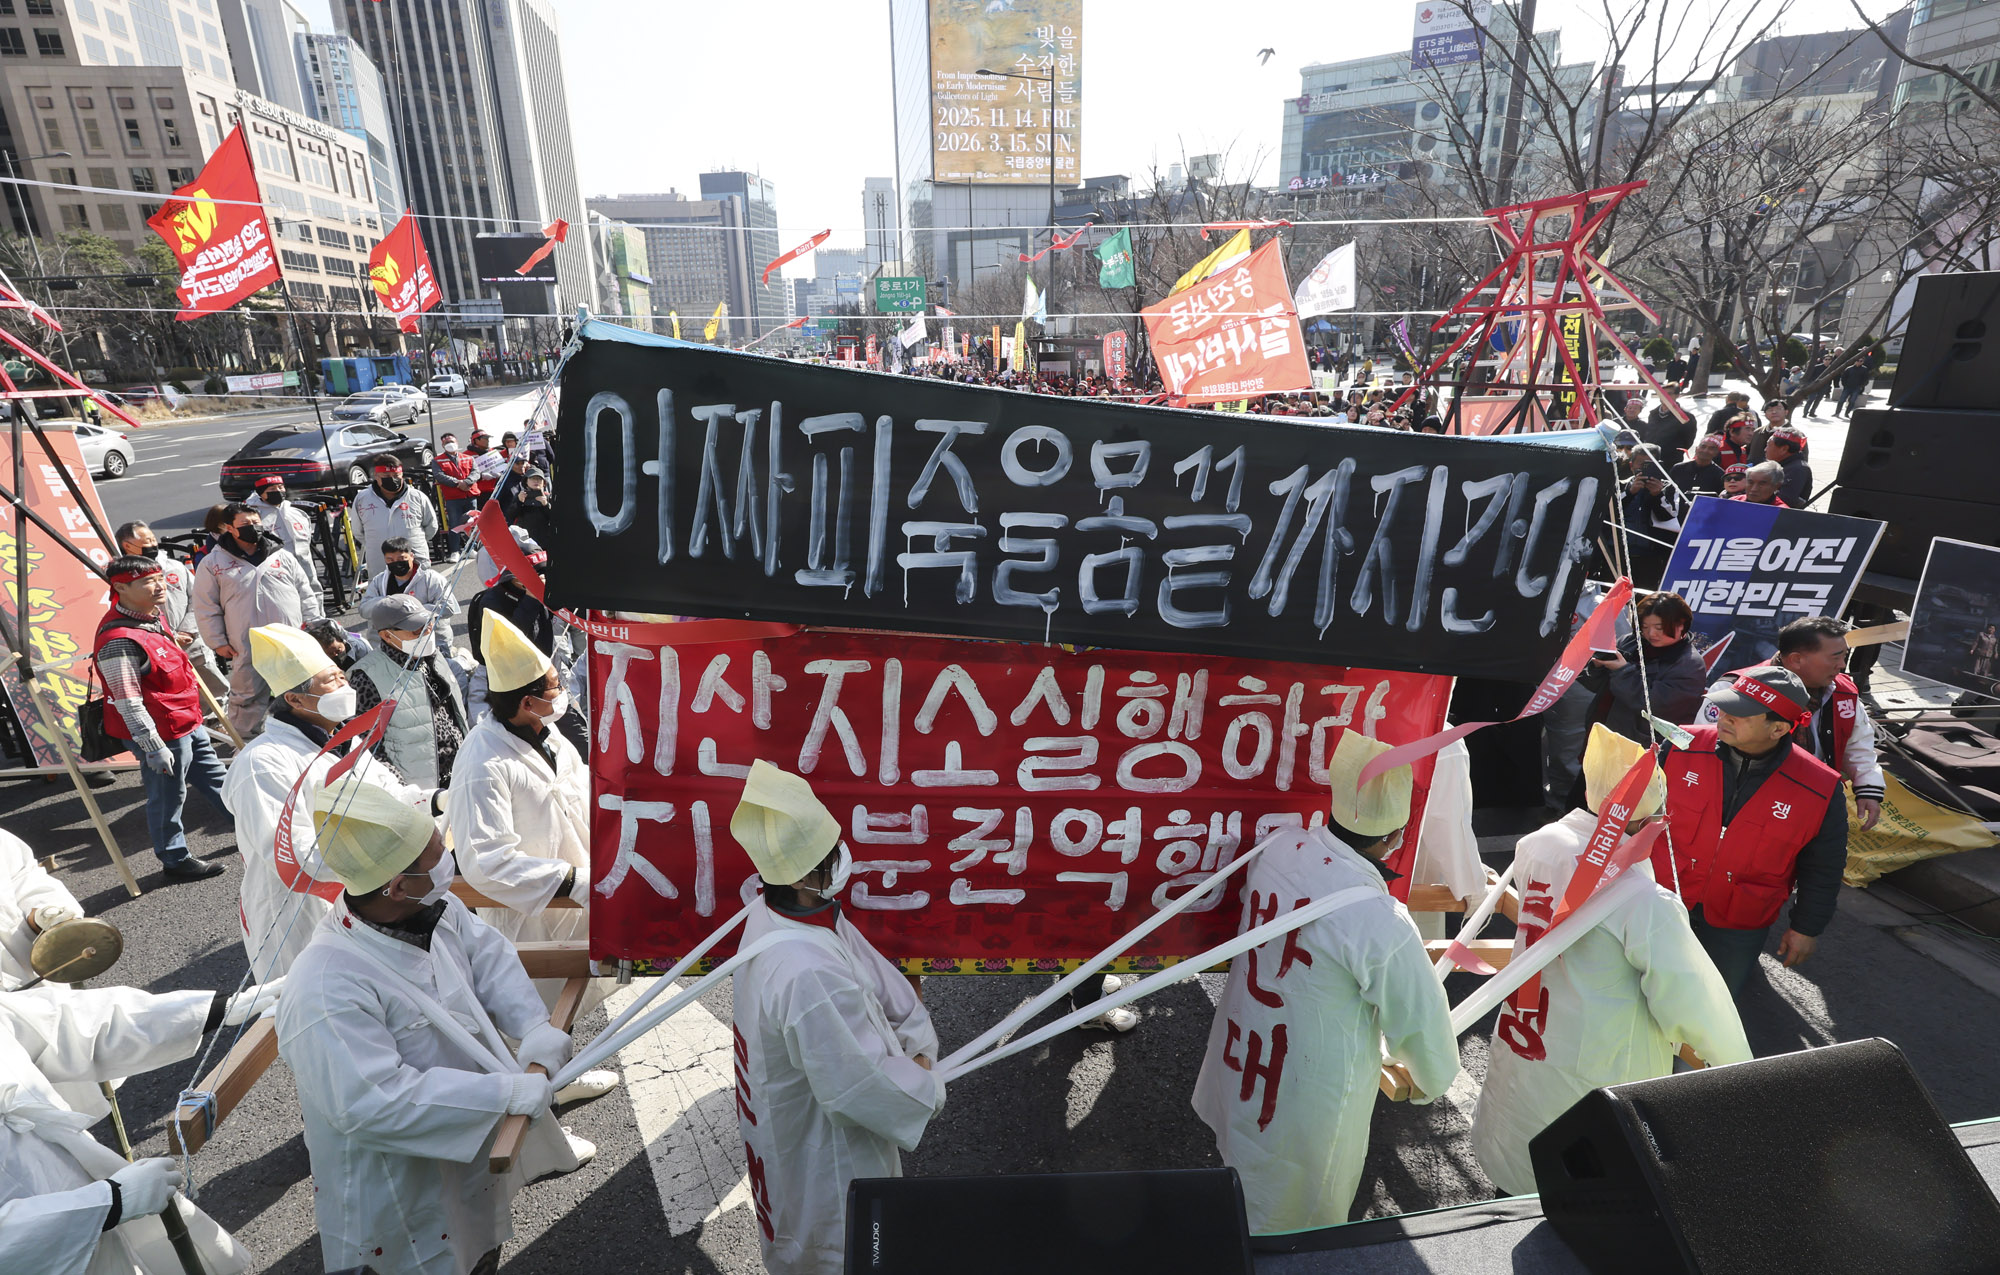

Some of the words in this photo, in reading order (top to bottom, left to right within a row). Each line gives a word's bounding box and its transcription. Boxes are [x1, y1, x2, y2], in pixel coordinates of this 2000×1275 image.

[1037, 24, 1077, 49] 빛을
[1419, 39, 1436, 49] ETS
[1418, 47, 1447, 58] TOEFL
[937, 71, 956, 79] From
[1015, 52, 1077, 77] 수집한
[937, 82, 945, 90] to
[946, 81, 965, 91] Early
[972, 92, 979, 100] of
[1015, 79, 1077, 104] 사람들
[937, 107, 985, 127] 2025.
[989, 108, 1010, 127] 11.
[1015, 108, 1037, 127] 14.
[1042, 109, 1076, 128] FRI.
[937, 132, 985, 152] 2026.
[989, 132, 1004, 152] 3.
[1009, 133, 1031, 152] 15.
[1035, 133, 1075, 153] SUN.
[1004, 156, 1075, 169] 국립중앙박물관
[879, 280, 920, 292] 종로1가
[1687, 537, 1858, 574] 기울어진
[1671, 579, 1834, 618] 대한민국
[558, 608, 629, 640] 결사반대
[1836, 699, 1856, 719] 쟁
[1682, 771, 1699, 787] 투
[1771, 800, 1792, 820] 쟁
[872, 1221, 880, 1267] TWAUDIO
